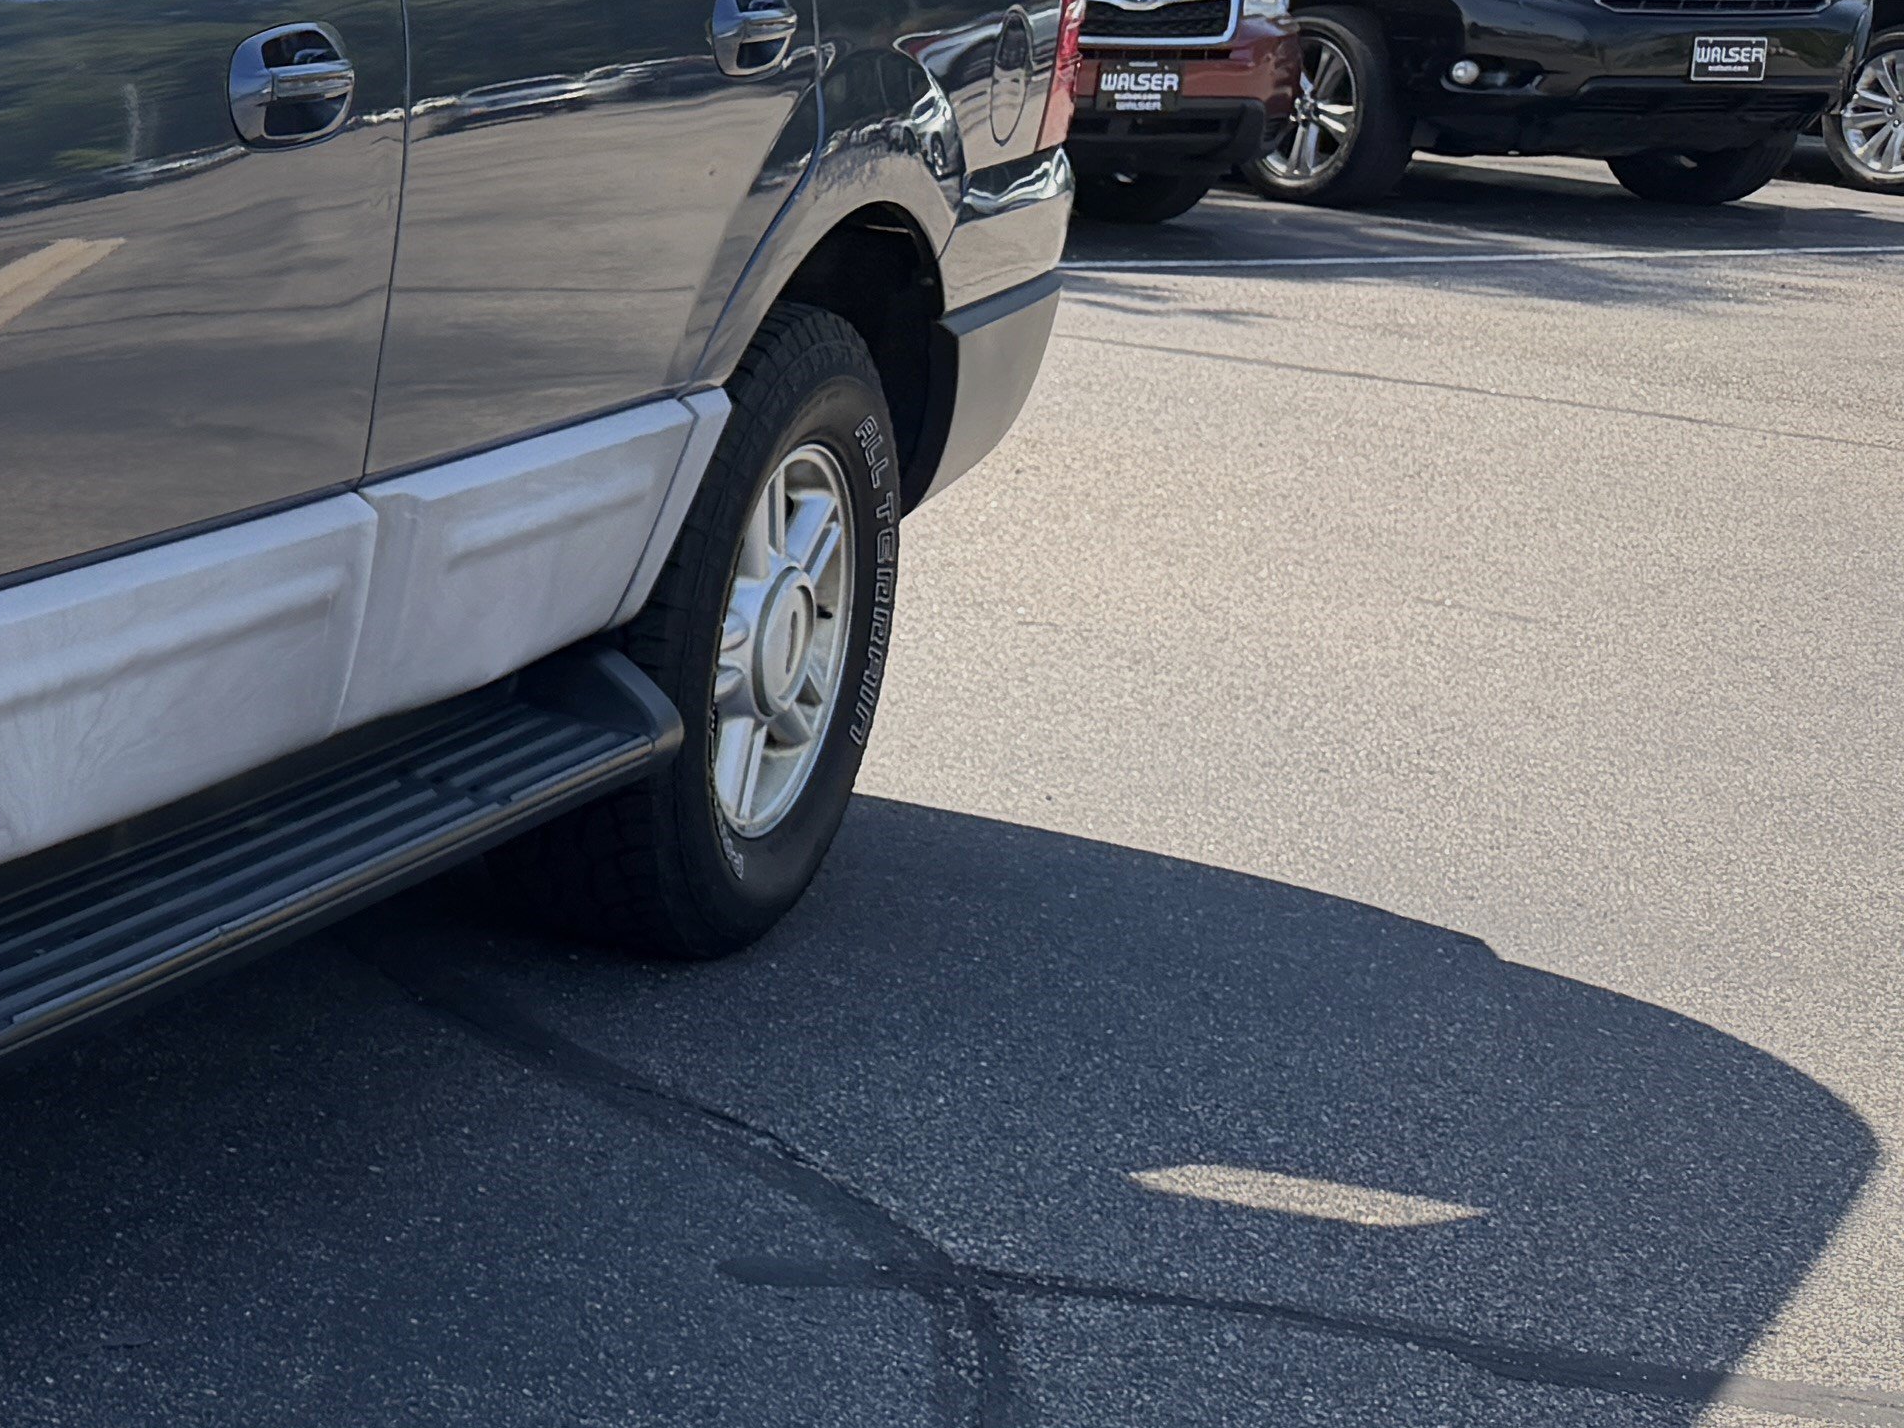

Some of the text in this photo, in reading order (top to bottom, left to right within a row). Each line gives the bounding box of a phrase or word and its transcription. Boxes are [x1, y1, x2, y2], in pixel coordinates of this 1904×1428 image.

[1695, 46, 1766, 63] WALSER
[1100, 73, 1179, 91] WALSER
[849, 415, 895, 746] ALL TERRAIN
